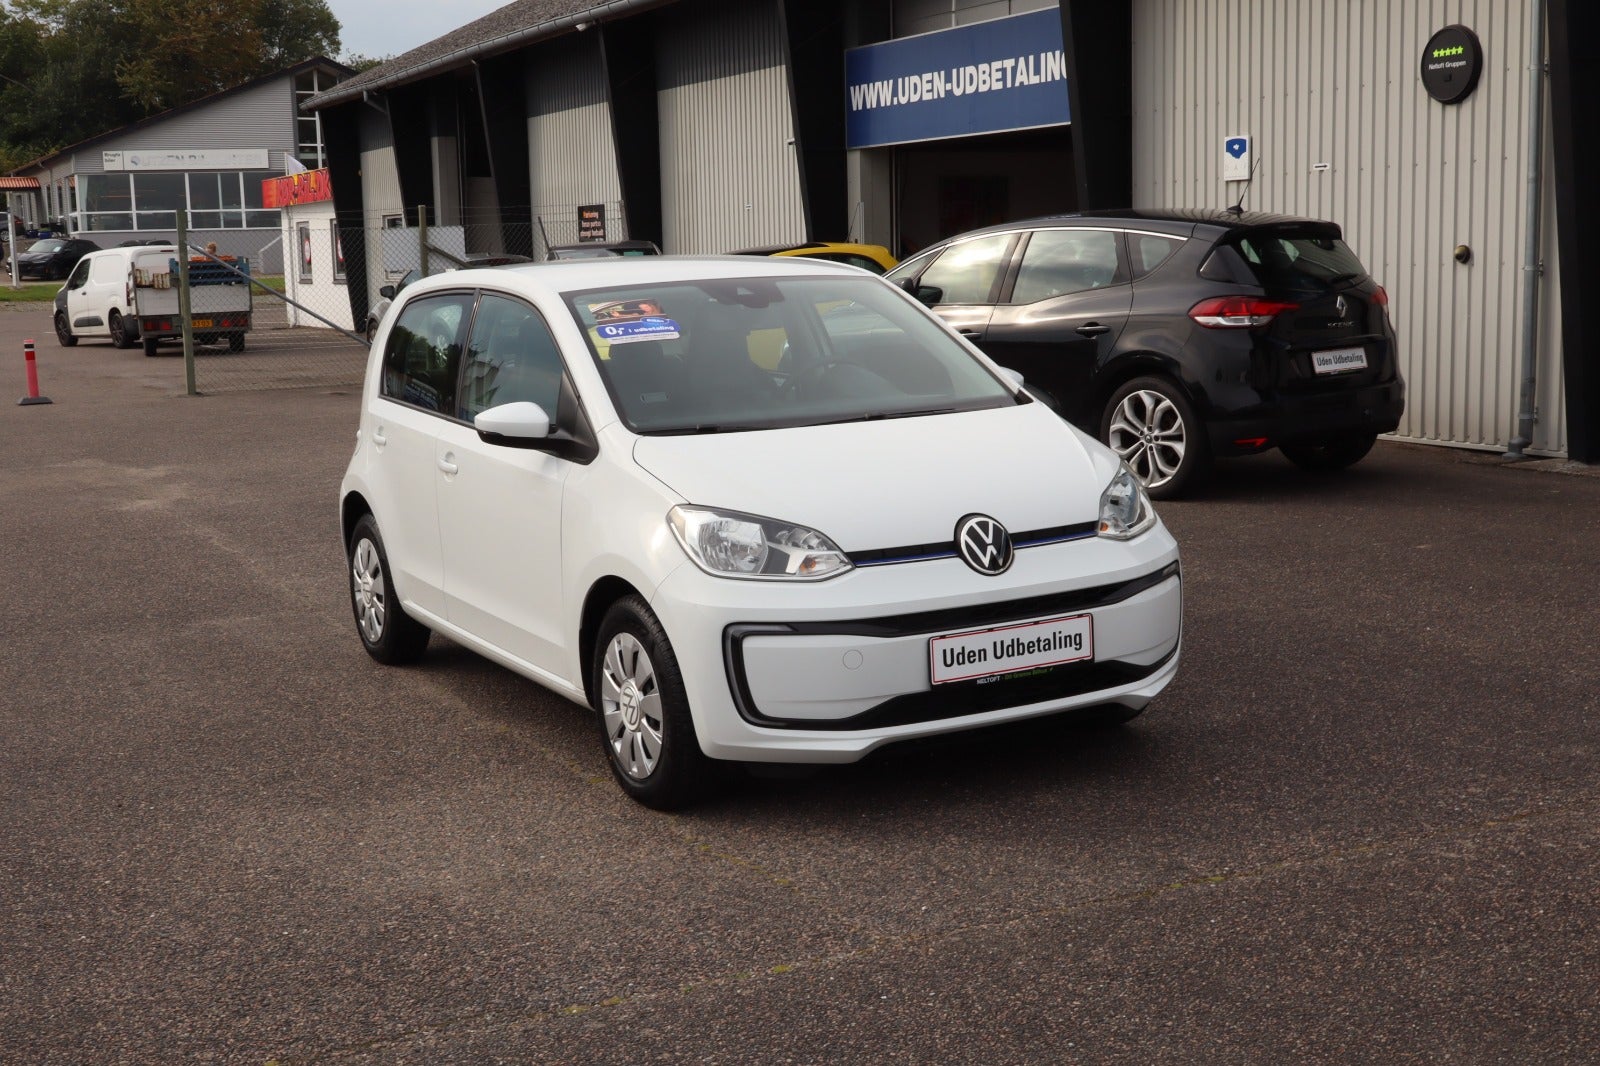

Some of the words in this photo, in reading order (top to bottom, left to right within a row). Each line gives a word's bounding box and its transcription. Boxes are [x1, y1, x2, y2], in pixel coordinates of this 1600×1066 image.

[1445, 60, 1466, 68] Gruppen
[634, 325, 675, 333] udbetaling
[1316, 356, 1333, 366] Uden
[1333, 353, 1364, 365] Udbetaling
[942, 646, 988, 668] Uden
[992, 630, 1083, 660] Udbetaling
